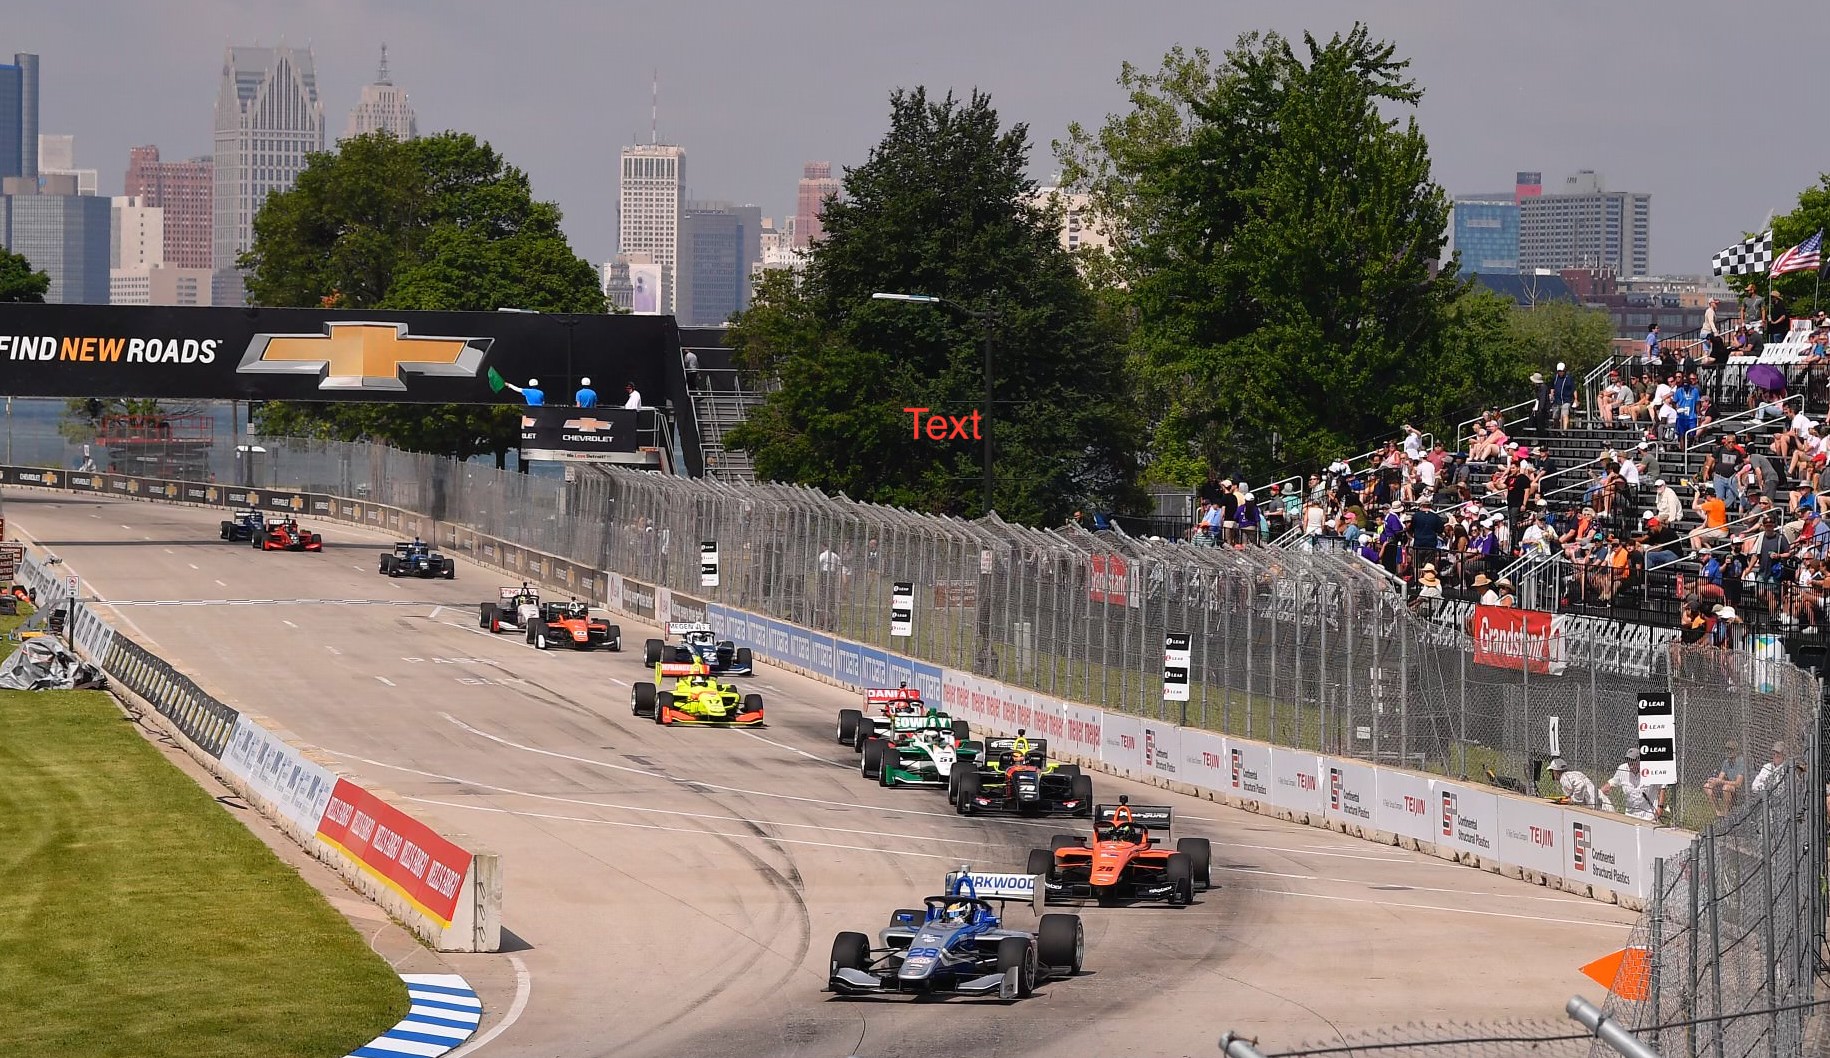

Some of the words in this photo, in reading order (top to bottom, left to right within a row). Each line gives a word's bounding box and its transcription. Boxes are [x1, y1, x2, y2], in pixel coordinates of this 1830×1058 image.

[0, 336, 57, 361] FIND
[60, 337, 125, 362] NEW
[562, 434, 614, 443] CHEVROLET
[1480, 616, 1547, 662] Grandstand
[868, 690, 914, 698] DANIAL
[1552, 722, 1556, 752] 1
[1202, 752, 1220, 770] TEIJIN
[1296, 772, 1316, 792] TEIJIN
[1404, 796, 1426, 817] TEIJIN
[1458, 814, 1478, 830] Continental
[1458, 829, 1476, 845] Structural
[1476, 834, 1490, 849] Plastics
[1529, 826, 1554, 848] TEIJIN
[1592, 848, 1616, 864] Continental
[961, 876, 1034, 890] IRKWOOD
[1592, 864, 1612, 880] Structural
[1614, 868, 1630, 886] Plastics
[908, 947, 939, 958] 28
